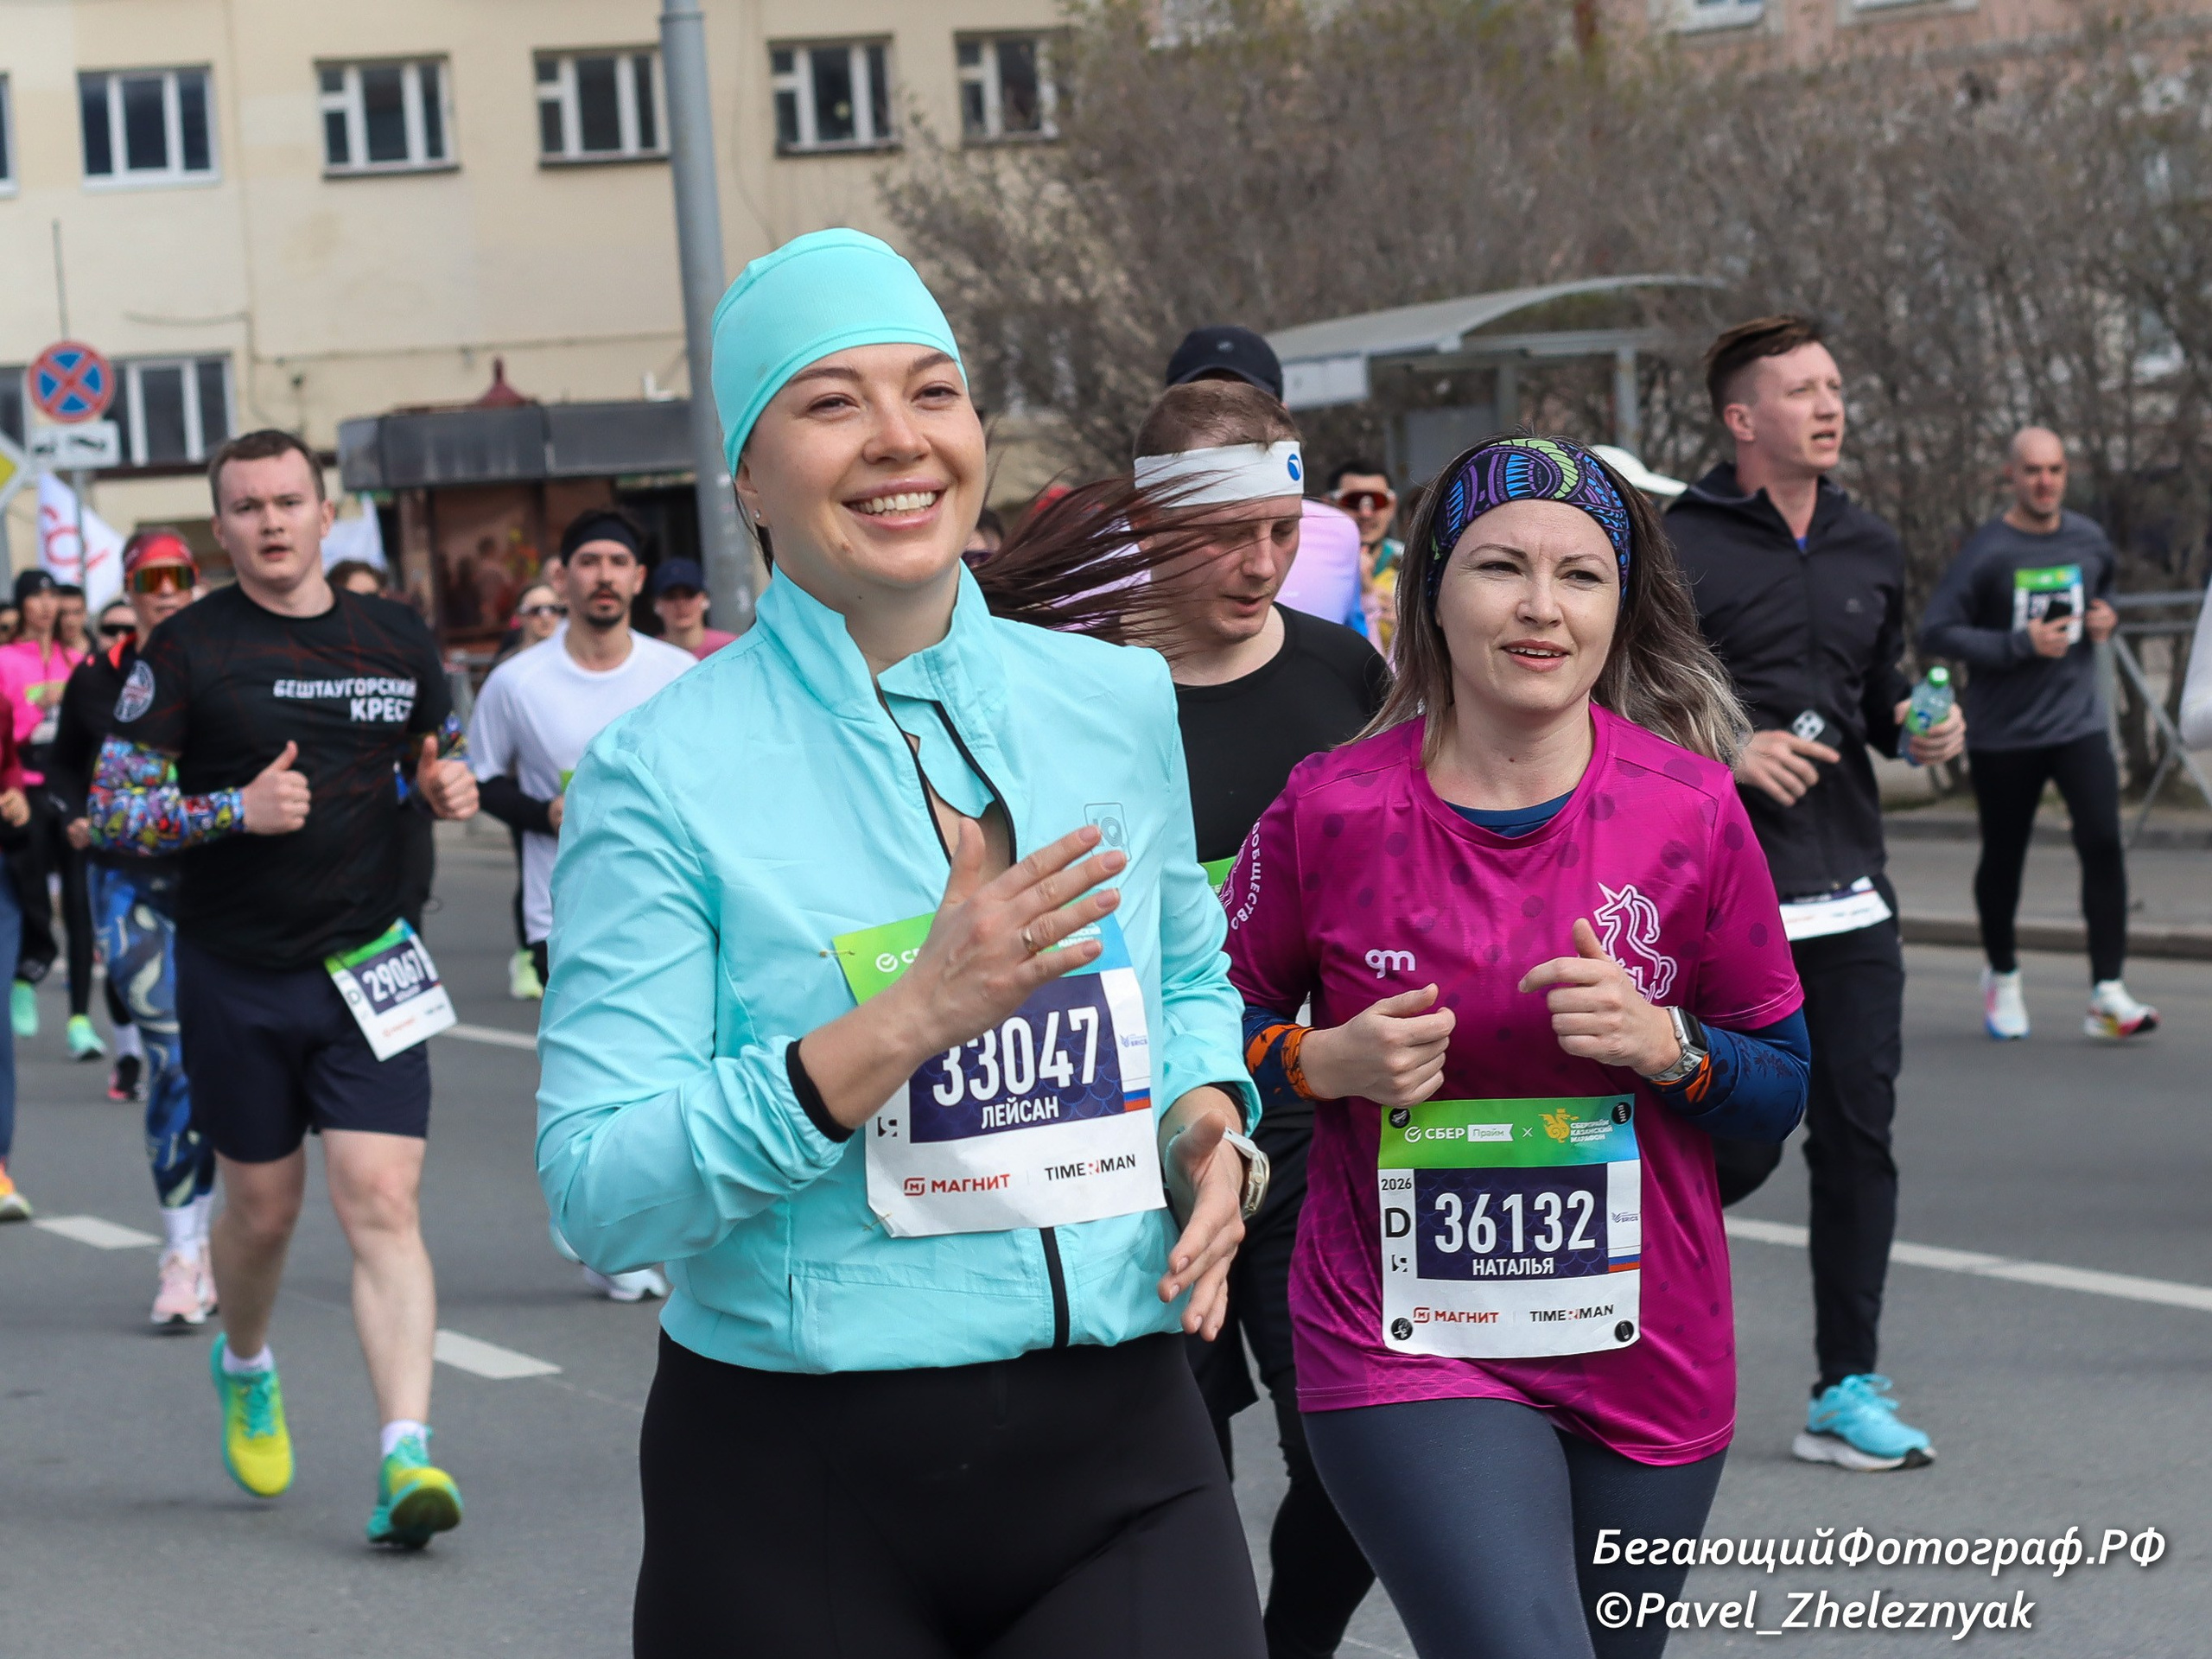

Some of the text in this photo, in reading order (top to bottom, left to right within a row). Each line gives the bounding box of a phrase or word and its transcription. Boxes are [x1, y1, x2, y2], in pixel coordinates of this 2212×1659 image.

[1230, 817, 1262, 930] ООБЩЕСТВО
[932, 1006, 1099, 1107] 33047
[981, 1095, 1059, 1129] ЛЕЙСАН
[1424, 1127, 1465, 1140] СБЕР
[1472, 1128, 1504, 1138] Прайм
[931, 1173, 1010, 1193] МАГНИТ
[1381, 1178, 1413, 1191] 2026
[1384, 1207, 1411, 1238] D
[1434, 1190, 1596, 1254] 36132
[1472, 1257, 1554, 1276] НАТАЛЬЯ
[1434, 1310, 1499, 1324] МАГНИТ
